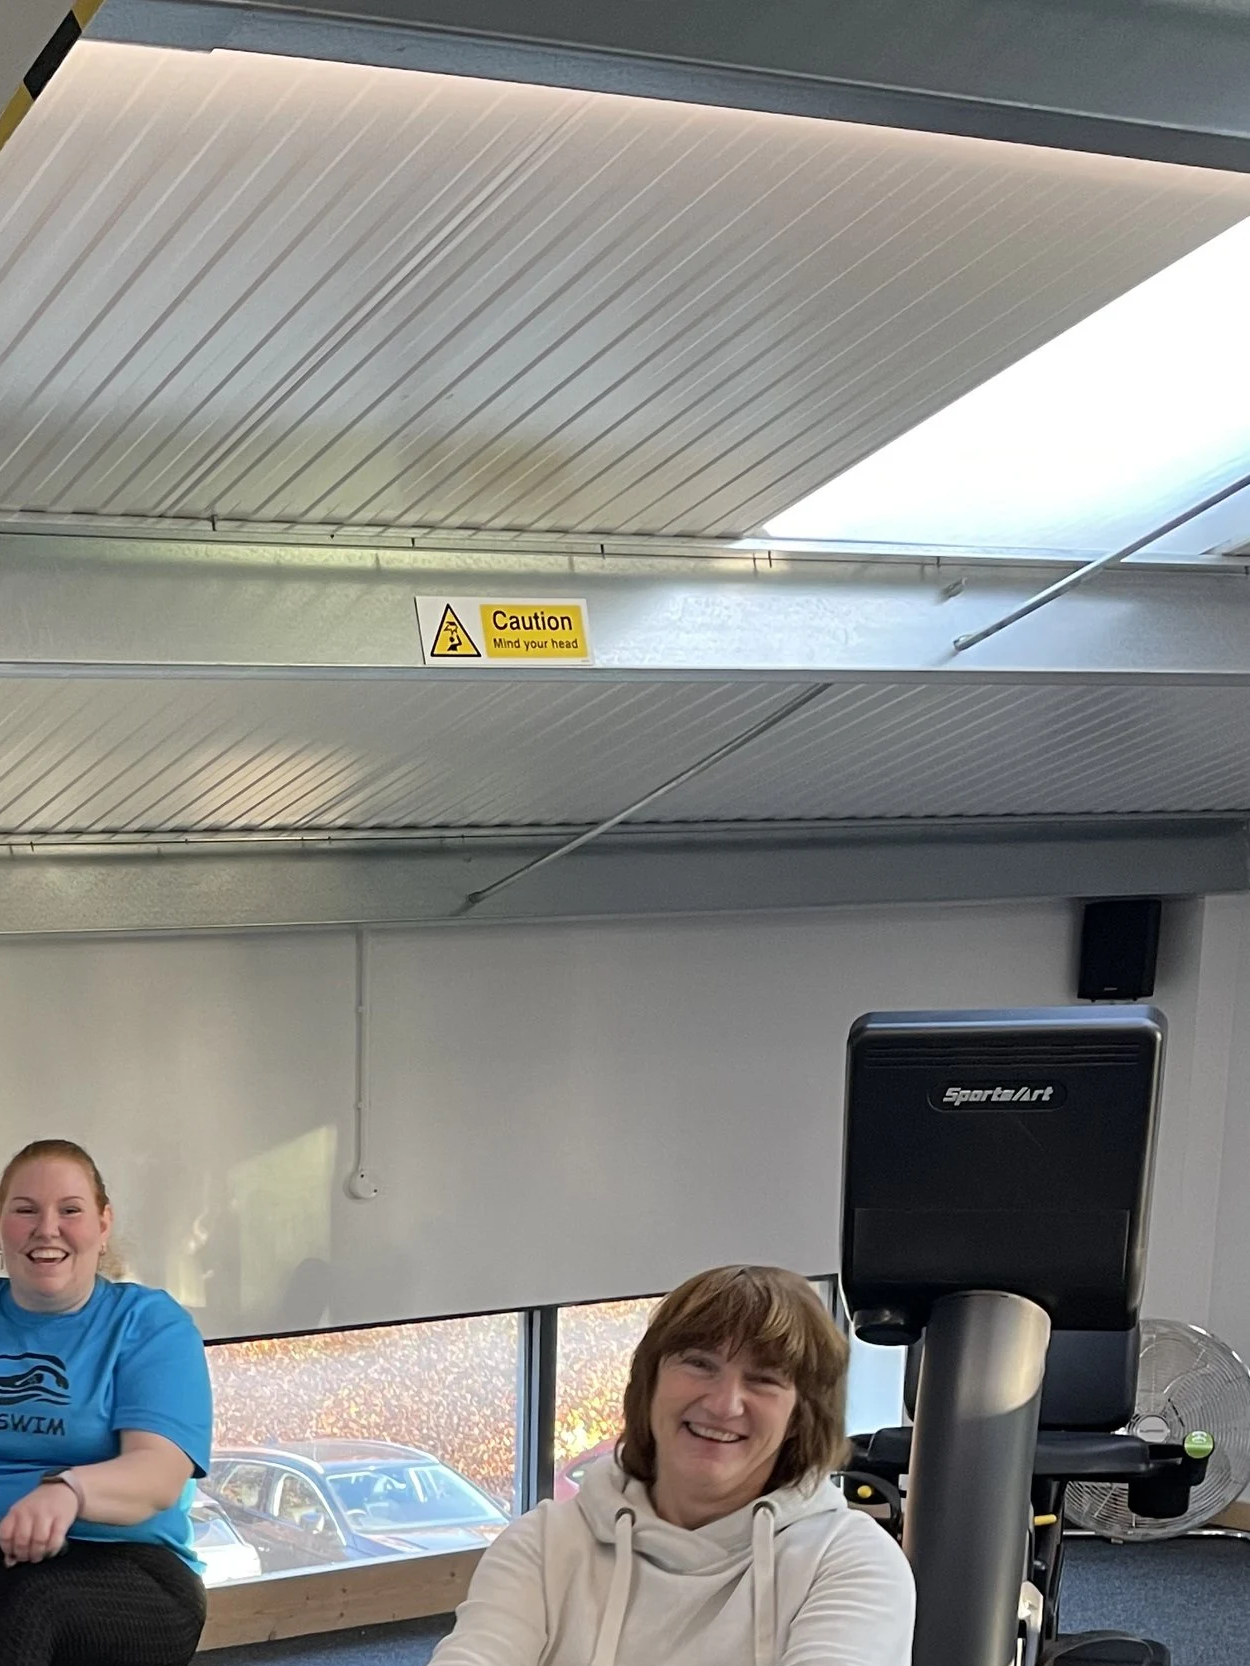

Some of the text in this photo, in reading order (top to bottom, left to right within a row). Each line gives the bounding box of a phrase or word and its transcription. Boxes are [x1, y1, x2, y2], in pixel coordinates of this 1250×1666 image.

[492, 610, 573, 631] Caution
[493, 637, 579, 651] Mind your head
[942, 1086, 1054, 1106] SportsArt
